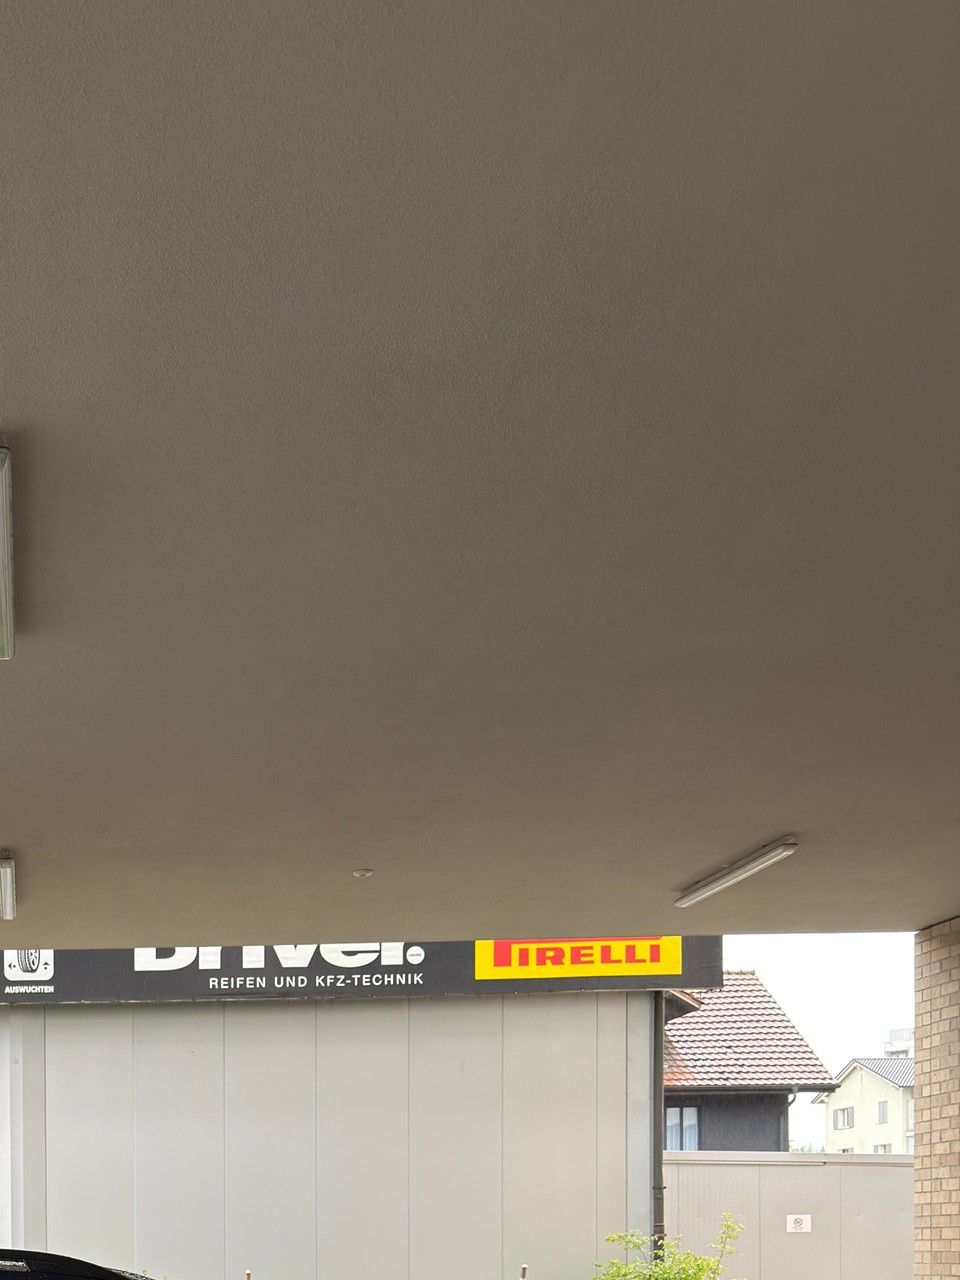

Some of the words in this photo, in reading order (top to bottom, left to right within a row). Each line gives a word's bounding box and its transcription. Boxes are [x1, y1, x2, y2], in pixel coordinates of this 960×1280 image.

[209, 976, 266, 989] REIFEN
[274, 975, 308, 988] UND
[316, 972, 424, 987] KFZ-TECHNIK
[4, 985, 55, 994] AUSWUCHTEN
